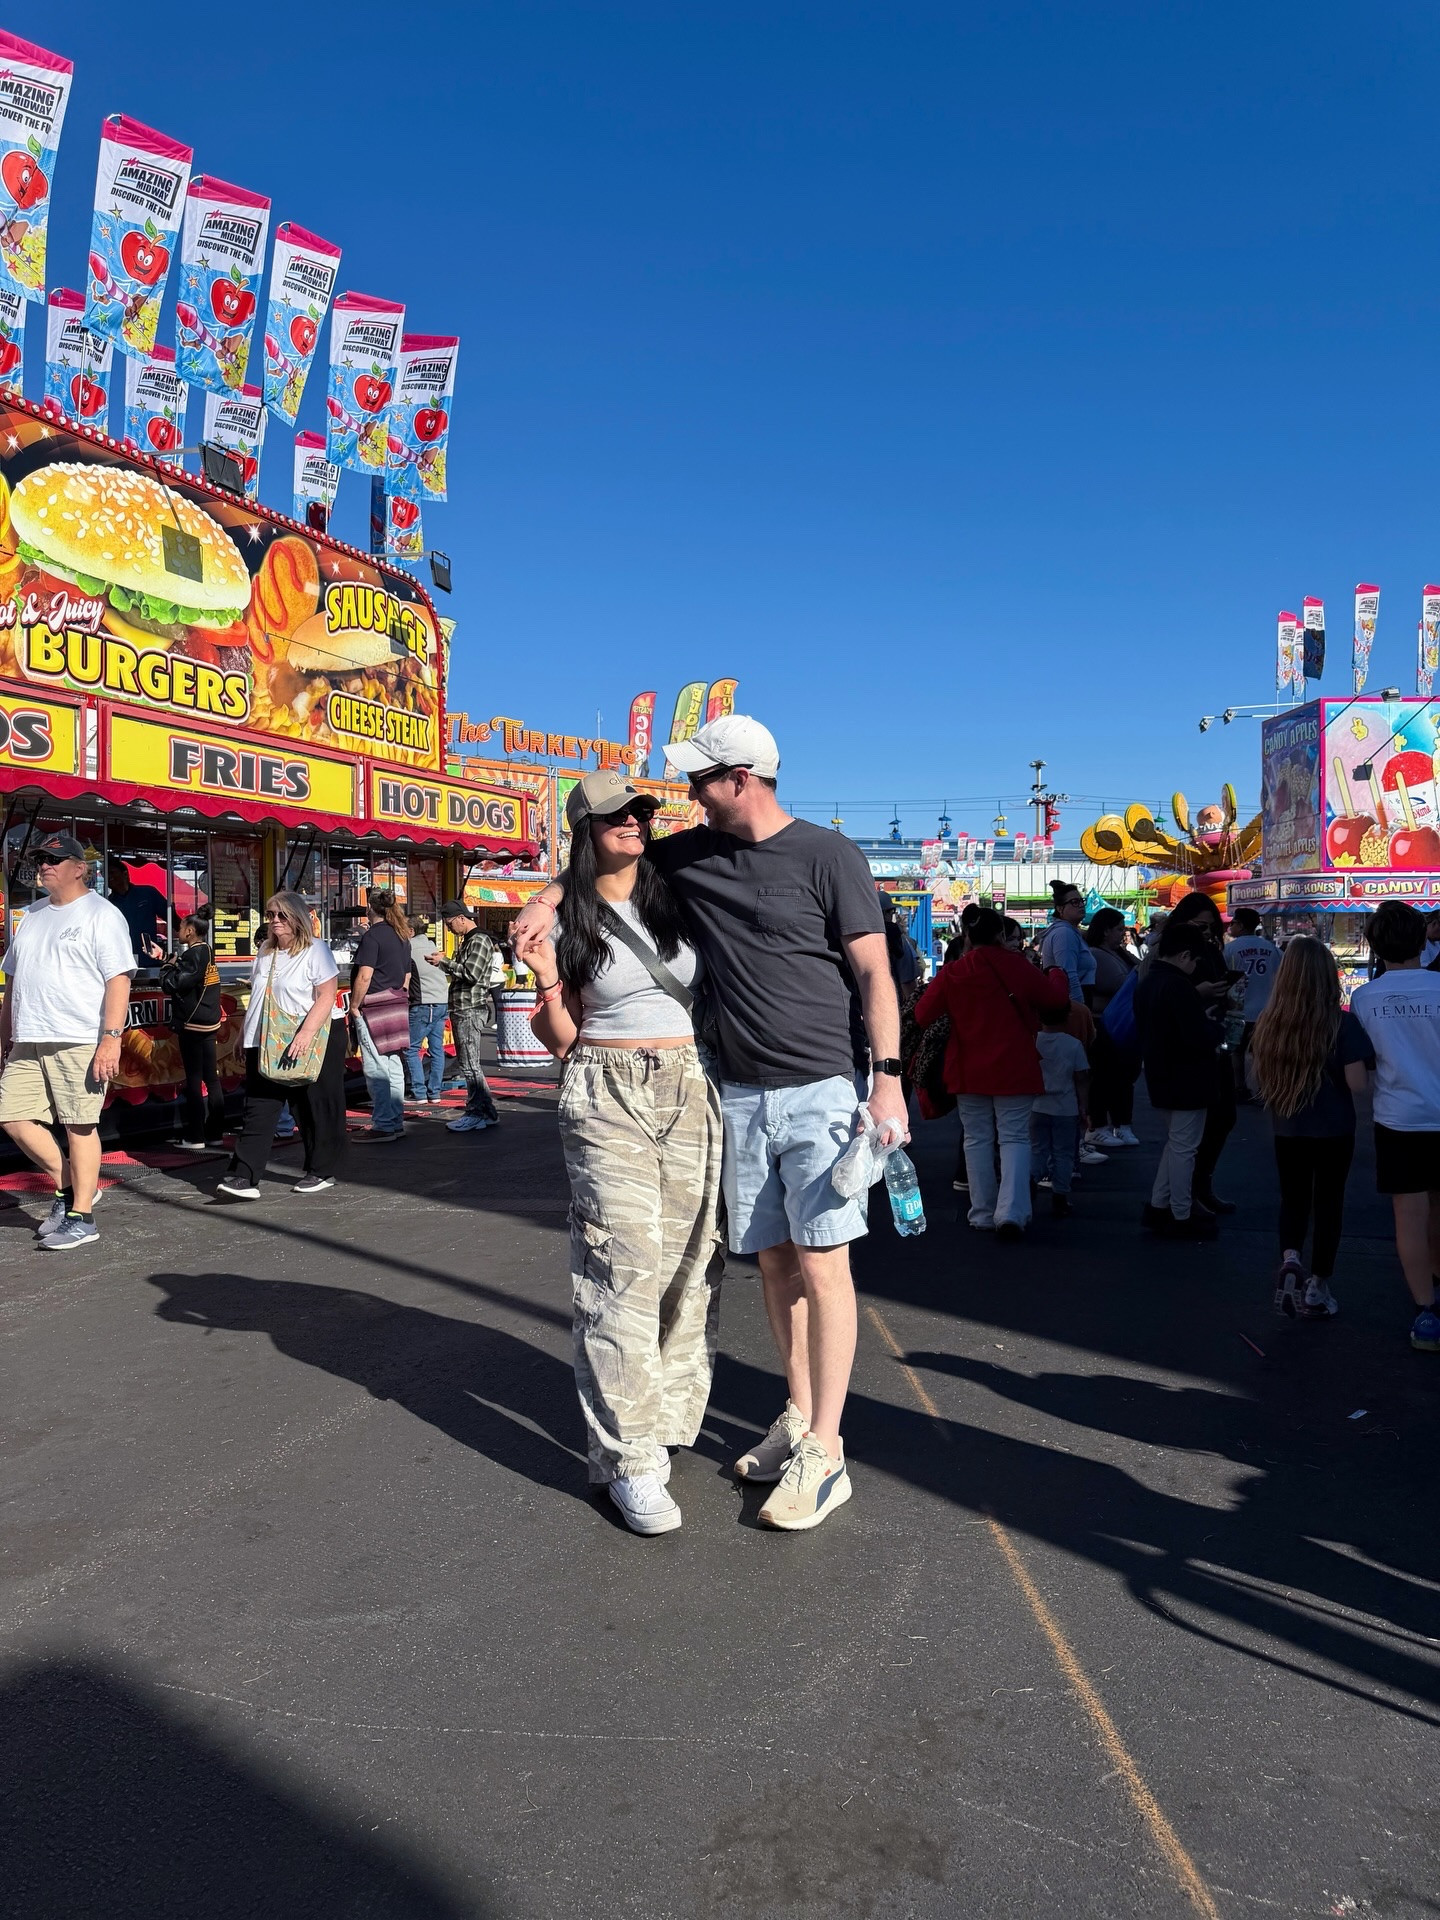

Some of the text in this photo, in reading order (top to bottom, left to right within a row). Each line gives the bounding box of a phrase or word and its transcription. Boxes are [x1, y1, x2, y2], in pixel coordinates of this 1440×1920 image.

[0, 81, 55, 106] MAZING
[12, 95, 52, 115] MIDWAY
[0, 106, 52, 134] COVER THE FU
[120, 167, 173, 193] AMAZING
[136, 181, 169, 202] MIDWAY
[110, 187, 172, 221] DISCOVER THE FUN
[205, 220, 255, 239] AMAZING
[220, 231, 252, 248] MIDWAY
[197, 239, 254, 266] DISCOVER THE FUN
[289, 263, 329, 282] AMAZING
[301, 274, 327, 290] MIDWAY
[282, 280, 307, 294] DISCOVER
[307, 288, 318, 300] THE
[348, 326, 391, 340] AMAZING
[362, 335, 389, 347] MIDWAY
[58, 342, 83, 353] DISCOVE
[342, 344, 392, 361] DISCOVER THE FUN
[407, 363, 448, 375] AMAZING
[420, 372, 446, 380] MIDWAY
[136, 388, 160, 399] DISCOVER
[161, 393, 171, 403] THE
[220, 407, 256, 421] AMAZING
[231, 415, 254, 427] MIDWAY
[214, 422, 257, 440] DISCOVER THE FUN
[306, 461, 336, 473] AMAZIG
[314, 469, 334, 479] MIDWY
[0, 591, 104, 632] ot & Juicy
[327, 586, 428, 664] SAUSAGE
[28, 624, 248, 718] BURGERS
[330, 694, 430, 750] CHEESE STEAK
[0, 711, 50, 757] S
[445, 712, 637, 771] The TURKEY LEG
[1264, 721, 1318, 756] CANDY APPLES
[170, 737, 310, 799] FRIES
[380, 780, 441, 822] HOT
[448, 791, 517, 832] DOGS
[1265, 837, 1316, 859] CARAMEL APPLES
[1235, 884, 1272, 900] POPCORN
[1286, 881, 1335, 895] SNO-KONES
[1365, 879, 1424, 894] CANDY
[1245, 958, 1267, 976] 76
